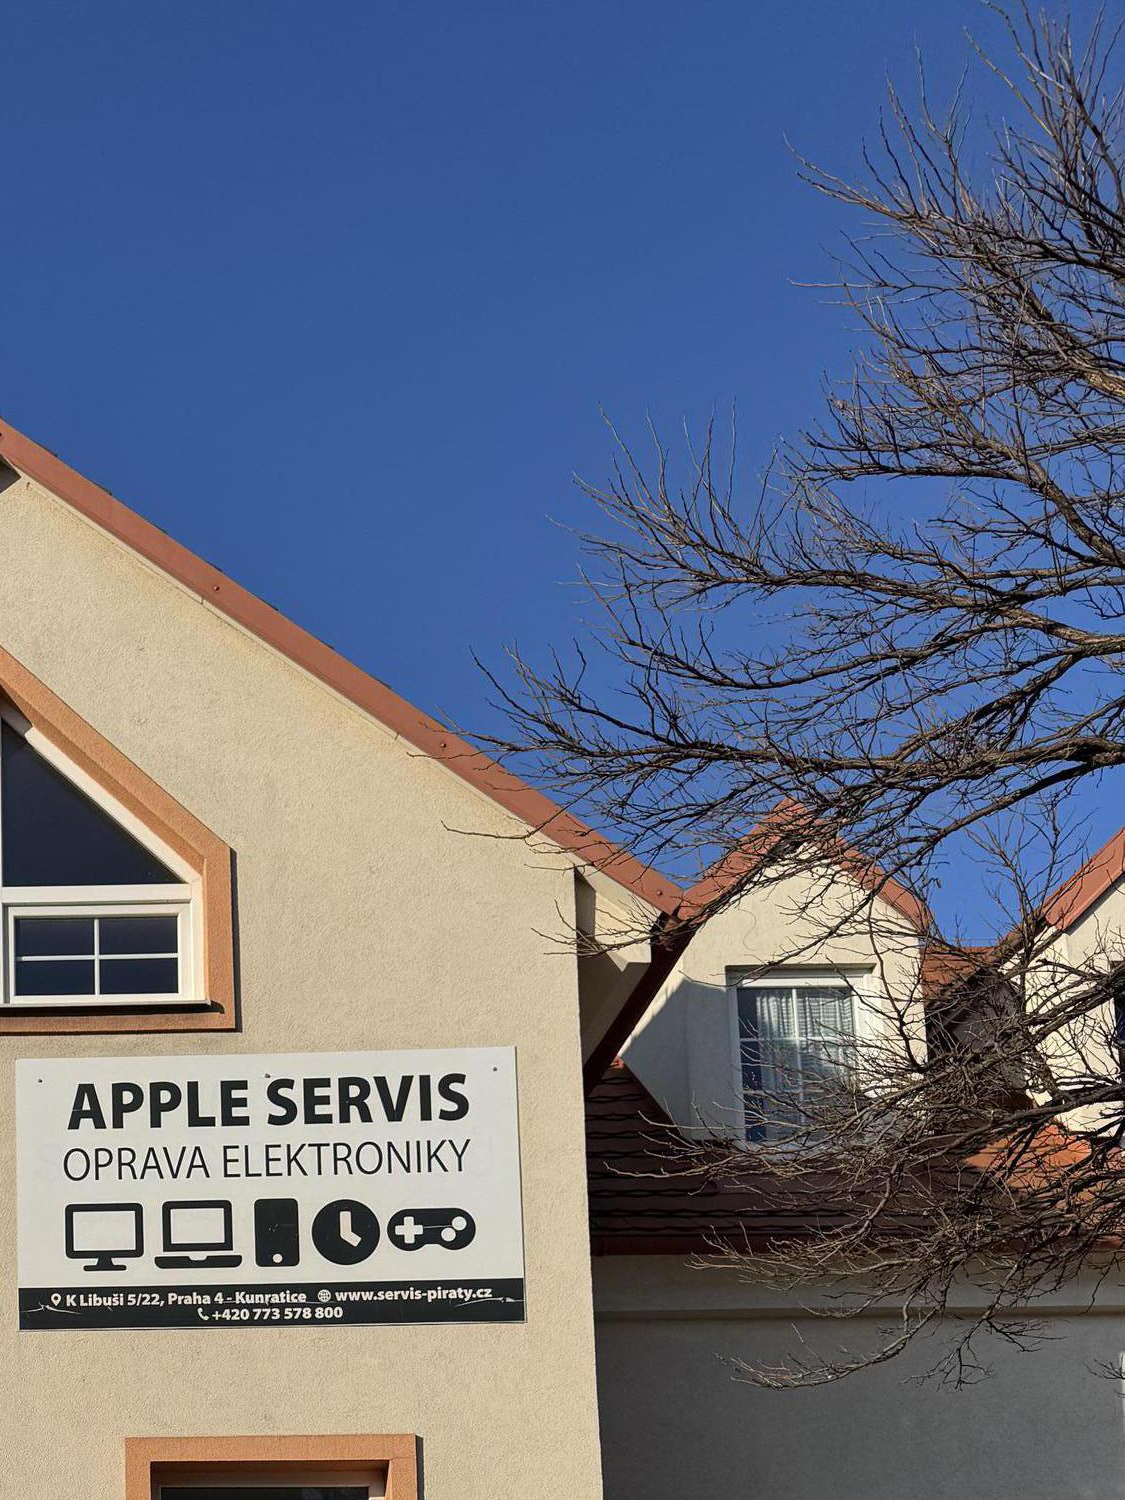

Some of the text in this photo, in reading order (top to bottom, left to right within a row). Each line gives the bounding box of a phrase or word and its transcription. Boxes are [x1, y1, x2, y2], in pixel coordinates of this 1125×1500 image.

[67, 1073, 470, 1131] APPLE SERVIS
[63, 1138, 472, 1182] OPRAVA ELEKTRONIKY
[66, 1294, 77, 1307] K
[79, 1292, 124, 1307] Libuši
[127, 1292, 165, 1308] 5/22,
[168, 1291, 211, 1306] Praha
[213, 1291, 225, 1305] 4
[235, 1289, 308, 1305] Kunratice
[335, 1286, 493, 1303] www.servis-piraty.cz
[212, 1306, 344, 1321] +420 773 578 800
